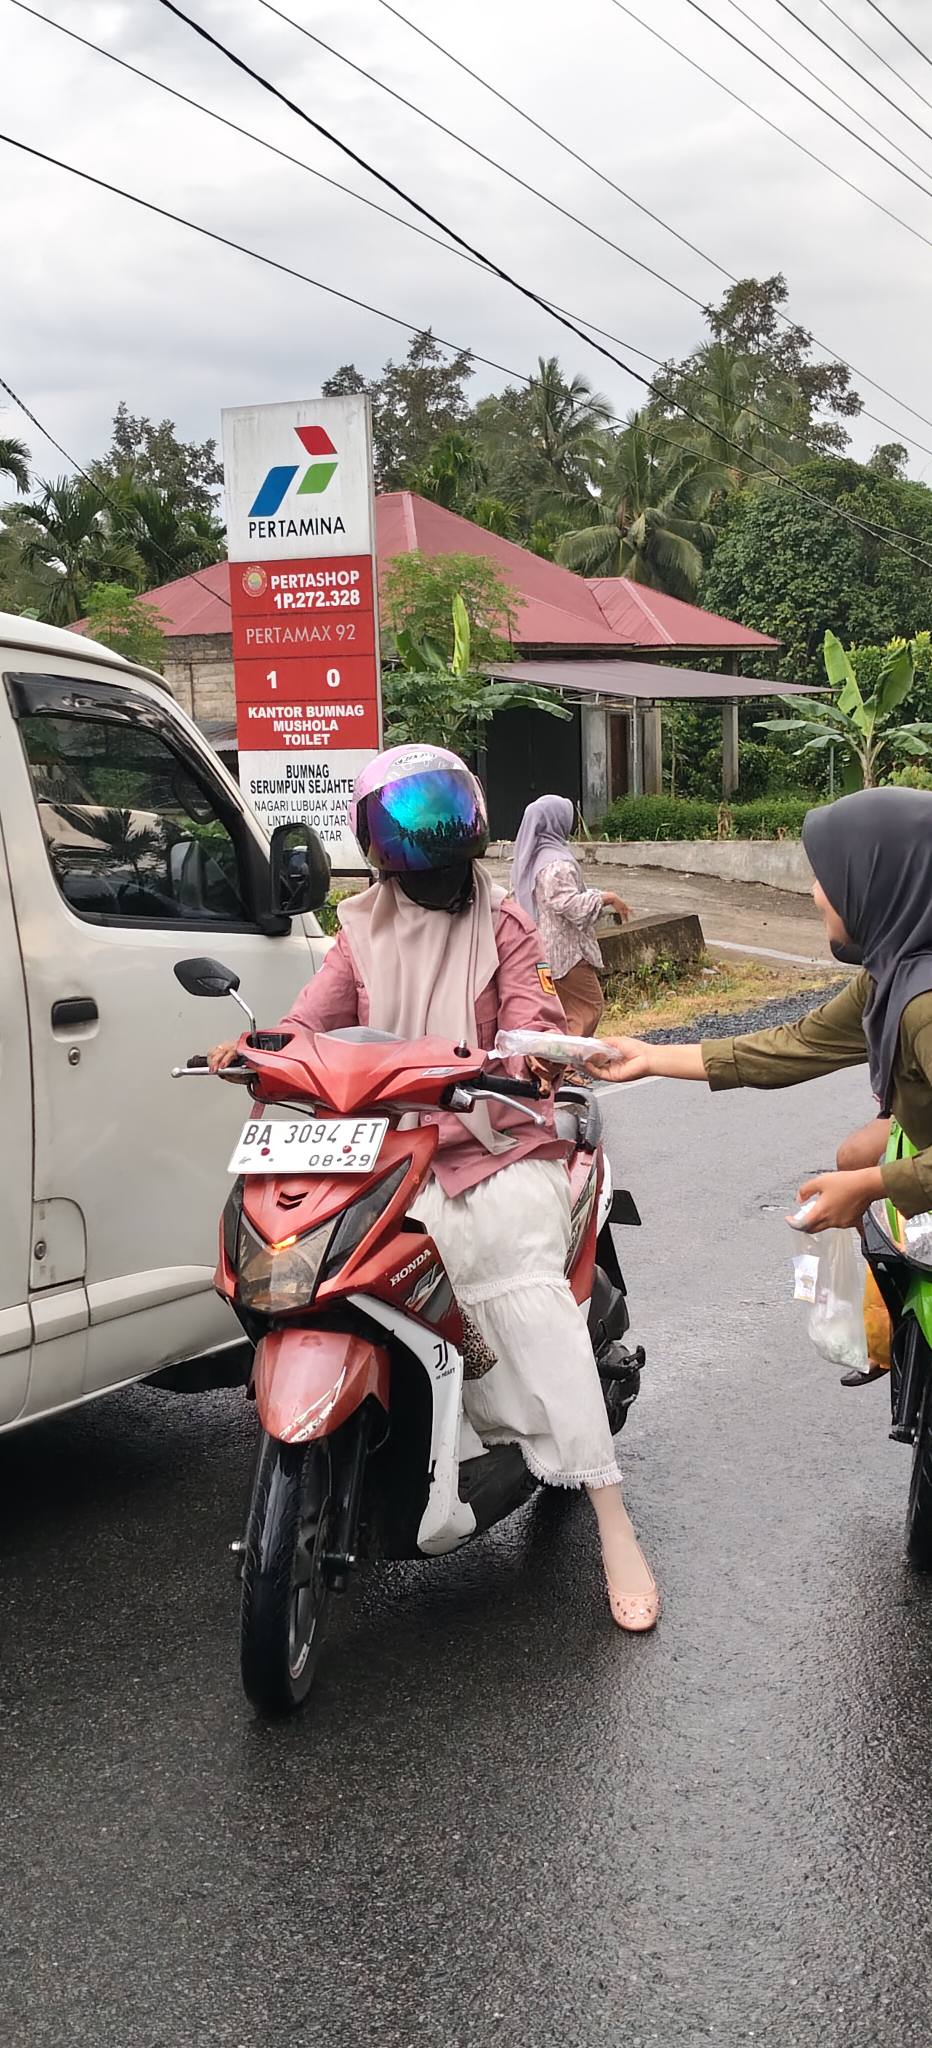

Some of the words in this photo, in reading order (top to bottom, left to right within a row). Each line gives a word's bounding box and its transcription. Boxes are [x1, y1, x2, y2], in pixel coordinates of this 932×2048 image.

[249, 516, 346, 539] PERTAMINA
[271, 570, 360, 590] PERTASHOP
[274, 589, 361, 609] 1P.272.328
[246, 625, 331, 645] PERTAMAX
[335, 623, 356, 641] 92
[266, 670, 278, 689] 1
[326, 668, 341, 688] 0
[248, 706, 303, 719] KANTOR
[306, 704, 365, 717] BUMNAG
[273, 719, 339, 732] MUSHOLA
[283, 733, 331, 746] TOILET
[286, 764, 330, 779] BUMNAG
[250, 780, 305, 795] SERUMPUN
[308, 779, 354, 794] SEJAHTE
[254, 800, 289, 812] NAGARI
[291, 800, 328, 812] LUBUAK
[322, 814, 349, 827] UTAR
[319, 830, 343, 841] ATAR
[243, 1124, 272, 1146] BA
[284, 1124, 341, 1144] 3094
[351, 1122, 383, 1144] ET
[389, 1248, 432, 1288] HONDA
